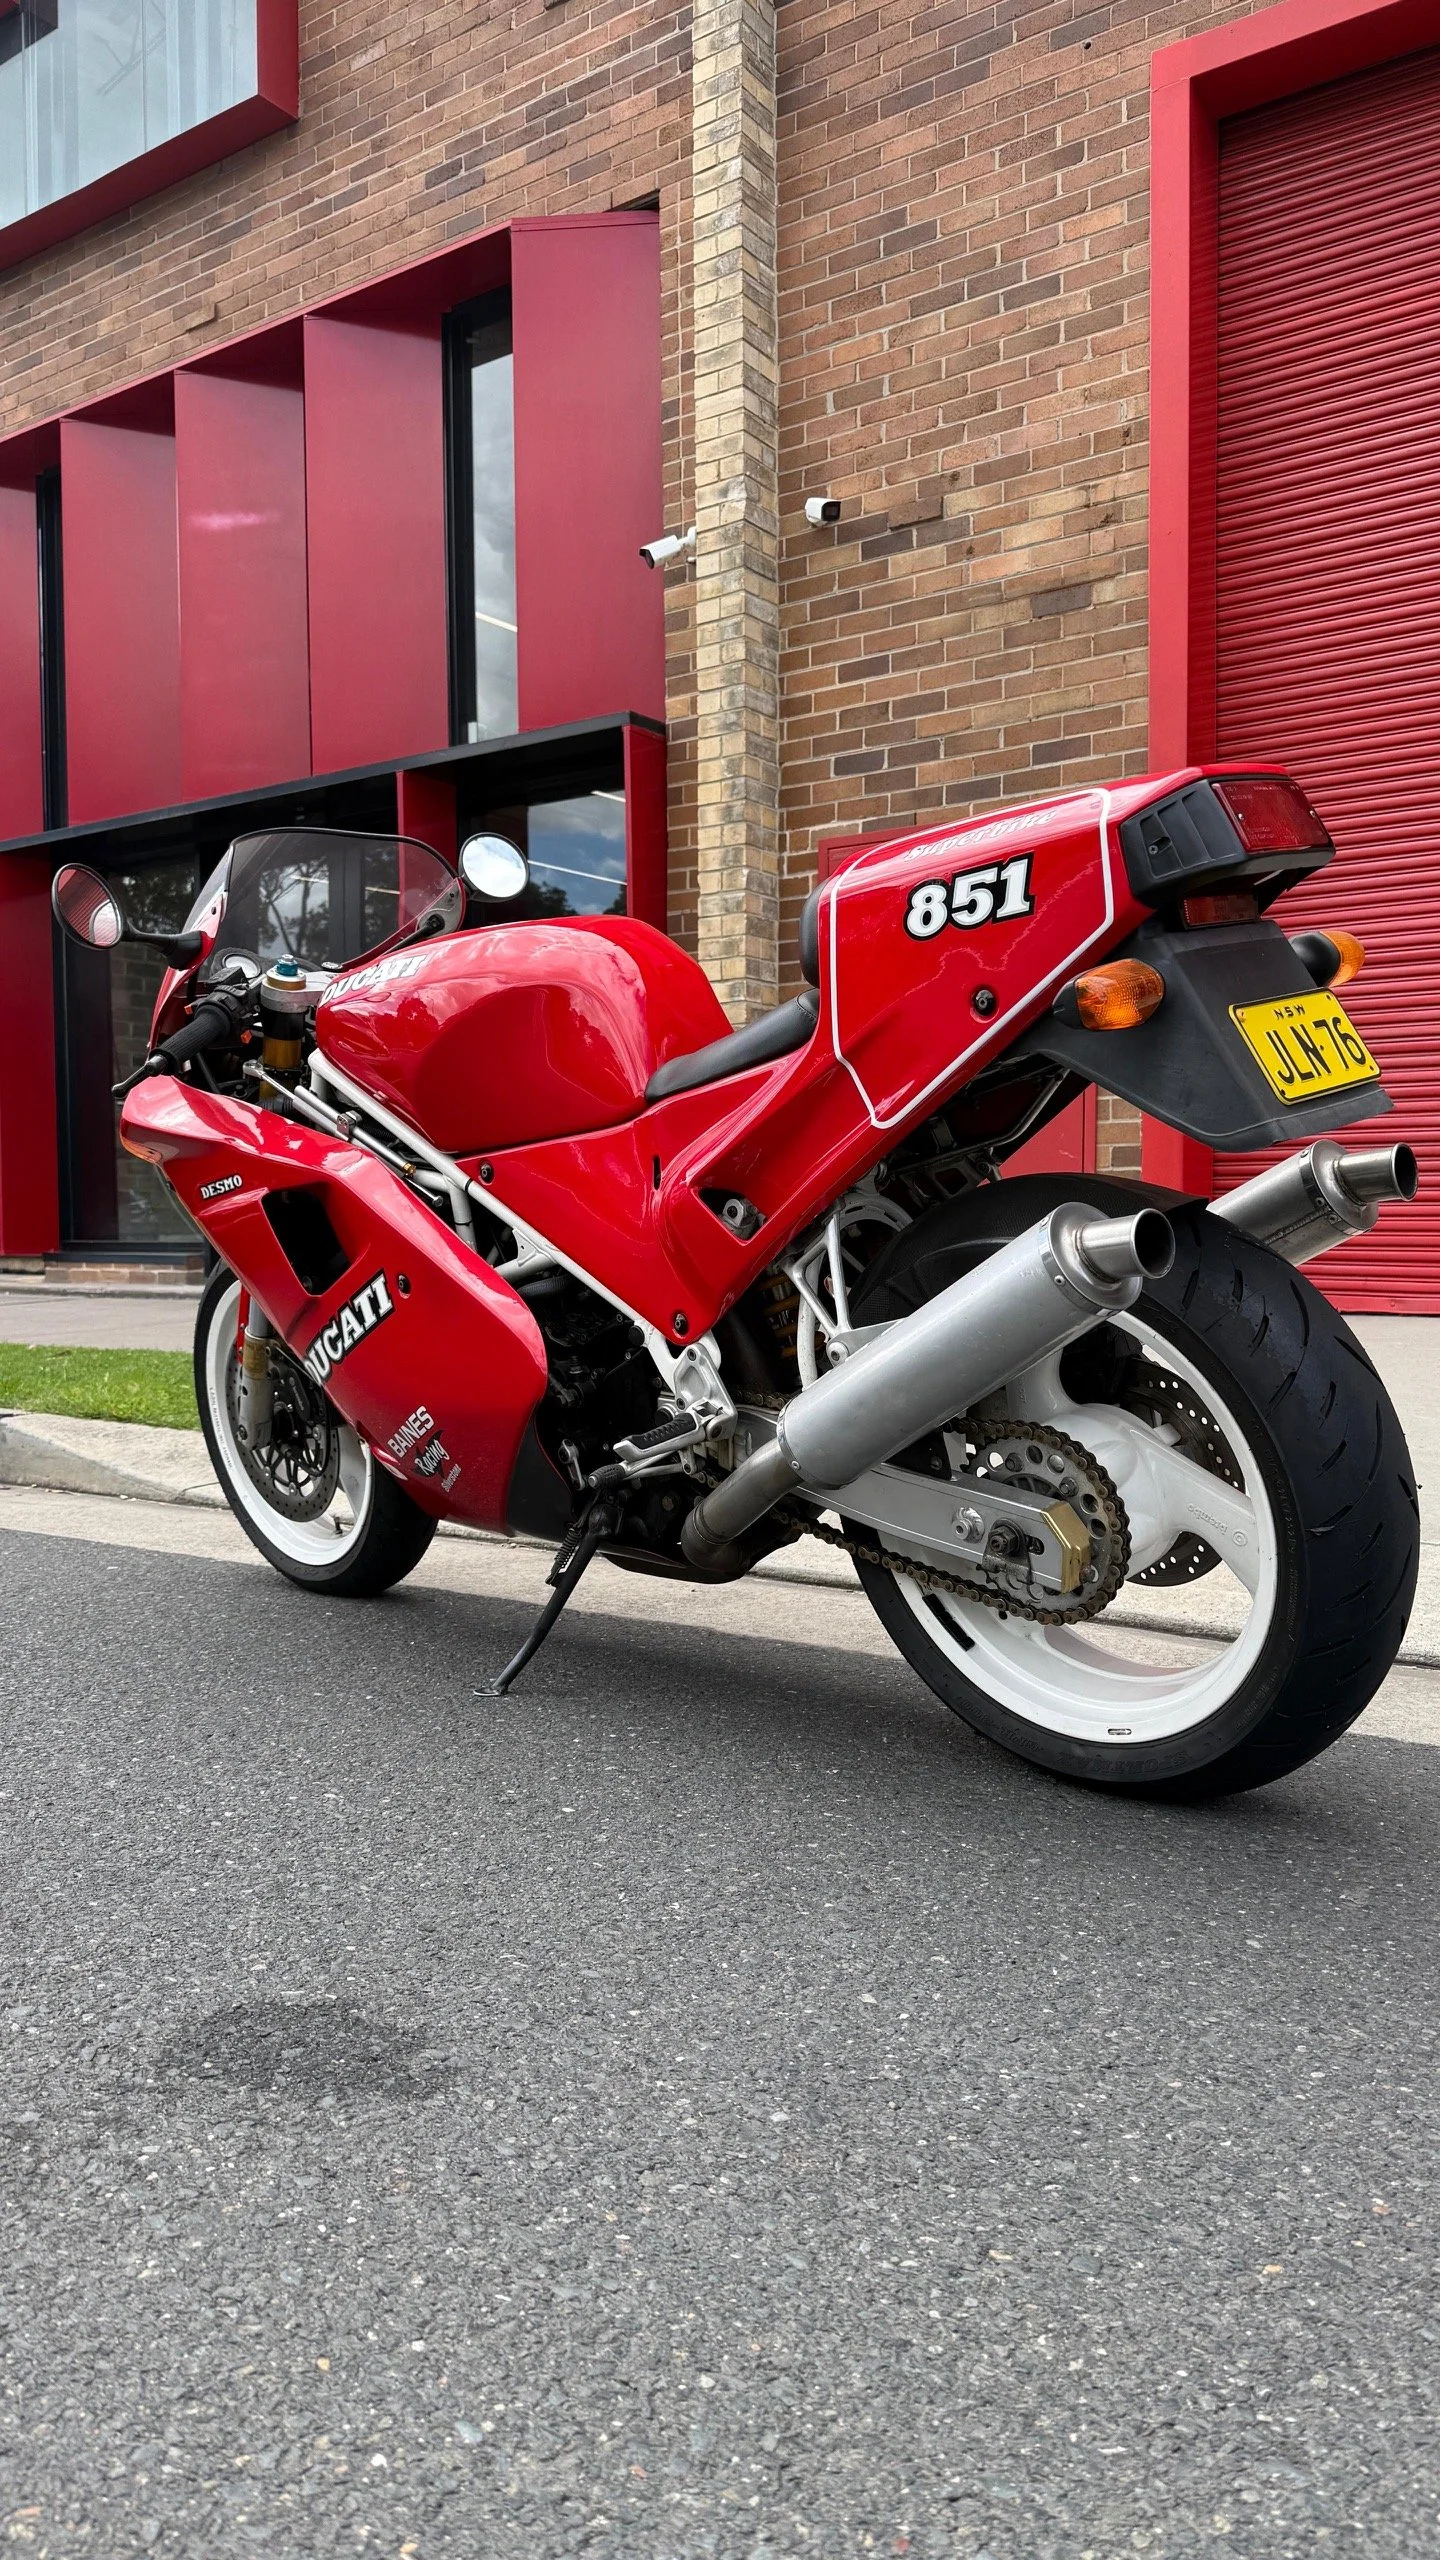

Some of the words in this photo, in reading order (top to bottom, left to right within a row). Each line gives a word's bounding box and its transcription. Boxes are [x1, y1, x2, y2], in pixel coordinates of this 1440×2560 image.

[904, 810, 1057, 862] Superbike
[905, 857, 1032, 938] 851
[320, 953, 428, 1007] DUCATI
[1273, 1004, 1306, 1020] NSW
[200, 1174, 243, 1199] DESMO
[387, 1405, 435, 1458] BAINES
[414, 1439, 450, 1476] Racing
